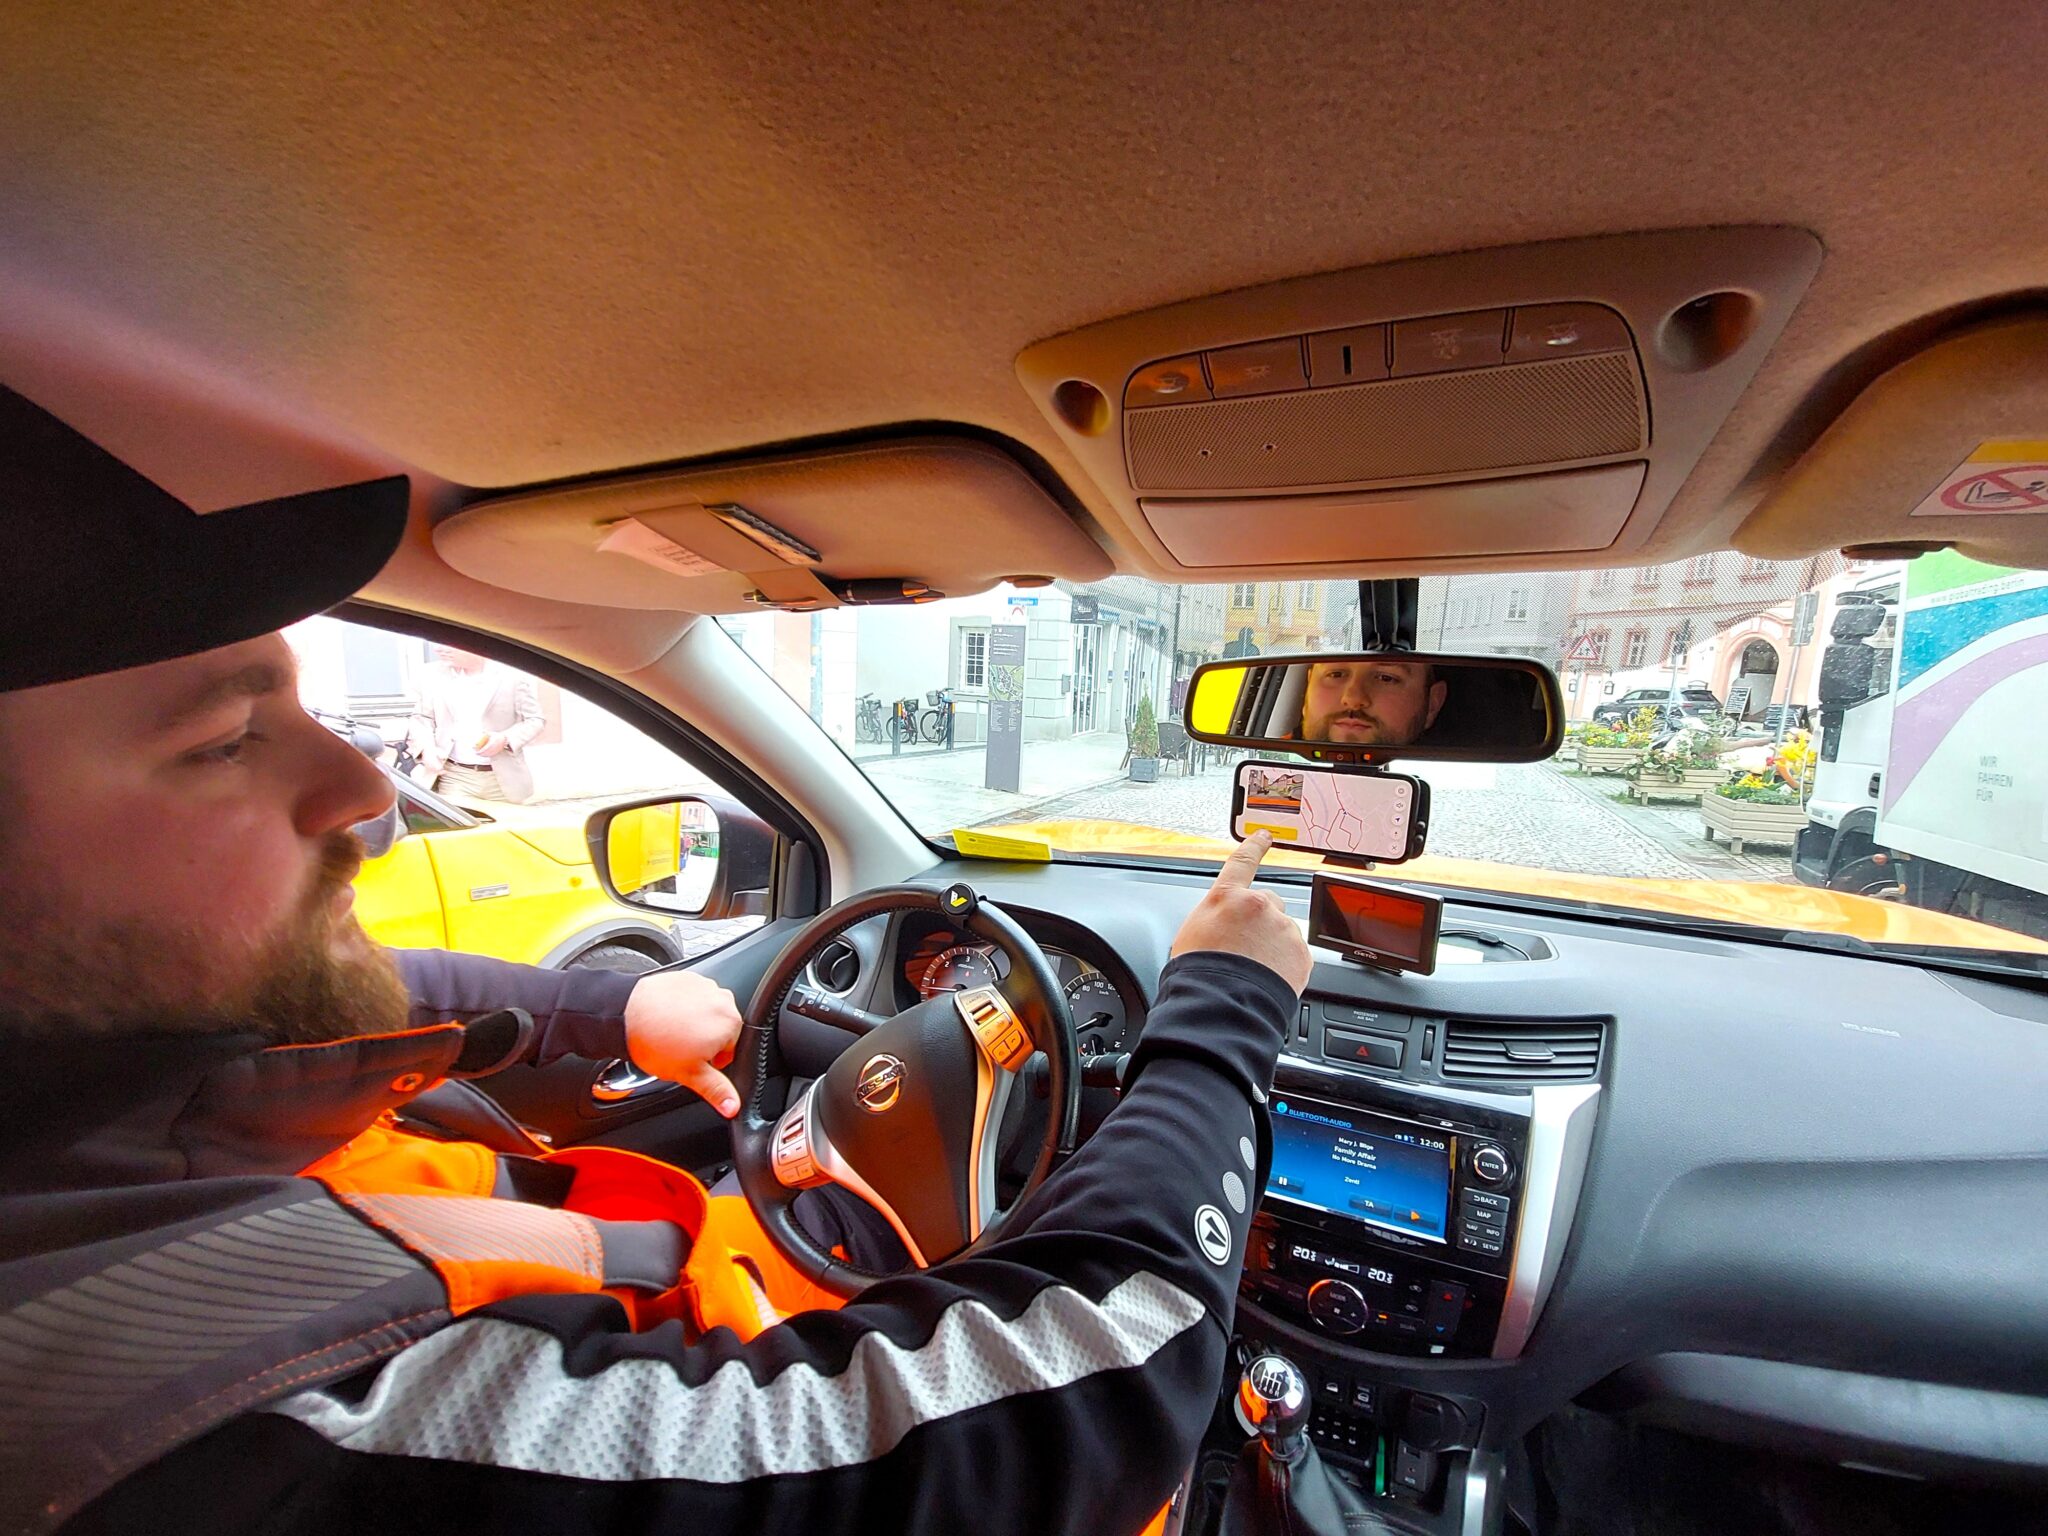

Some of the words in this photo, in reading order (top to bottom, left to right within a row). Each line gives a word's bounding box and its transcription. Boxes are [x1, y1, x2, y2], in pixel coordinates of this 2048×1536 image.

[1979, 755, 1998, 768] WIR
[1977, 771, 2014, 788] FAHREN
[1976, 786, 1994, 802] FÜR
[1071, 992, 1080, 1000] 60
[1082, 984, 1091, 992] 80
[1093, 981, 1104, 989] 100
[858, 1063, 903, 1100] NISSAN
[1288, 1108, 1353, 1129] BLUETOOTH-AUDIO
[1338, 1136, 1353, 1147] Mary
[1419, 1137, 1445, 1150] 12:00
[1334, 1145, 1357, 1158] Family
[1357, 1151, 1377, 1162] Affair
[1331, 1153, 1341, 1161] No
[1341, 1156, 1356, 1165] More
[1357, 1159, 1377, 1170] Drama
[1481, 1161, 1500, 1170] ENTER
[1364, 1199, 1375, 1209] TA
[1480, 1196, 1498, 1206] BACK
[1476, 1210, 1492, 1219] MAP
[1486, 1228, 1500, 1237] INFO
[1482, 1242, 1500, 1251] SETUP
